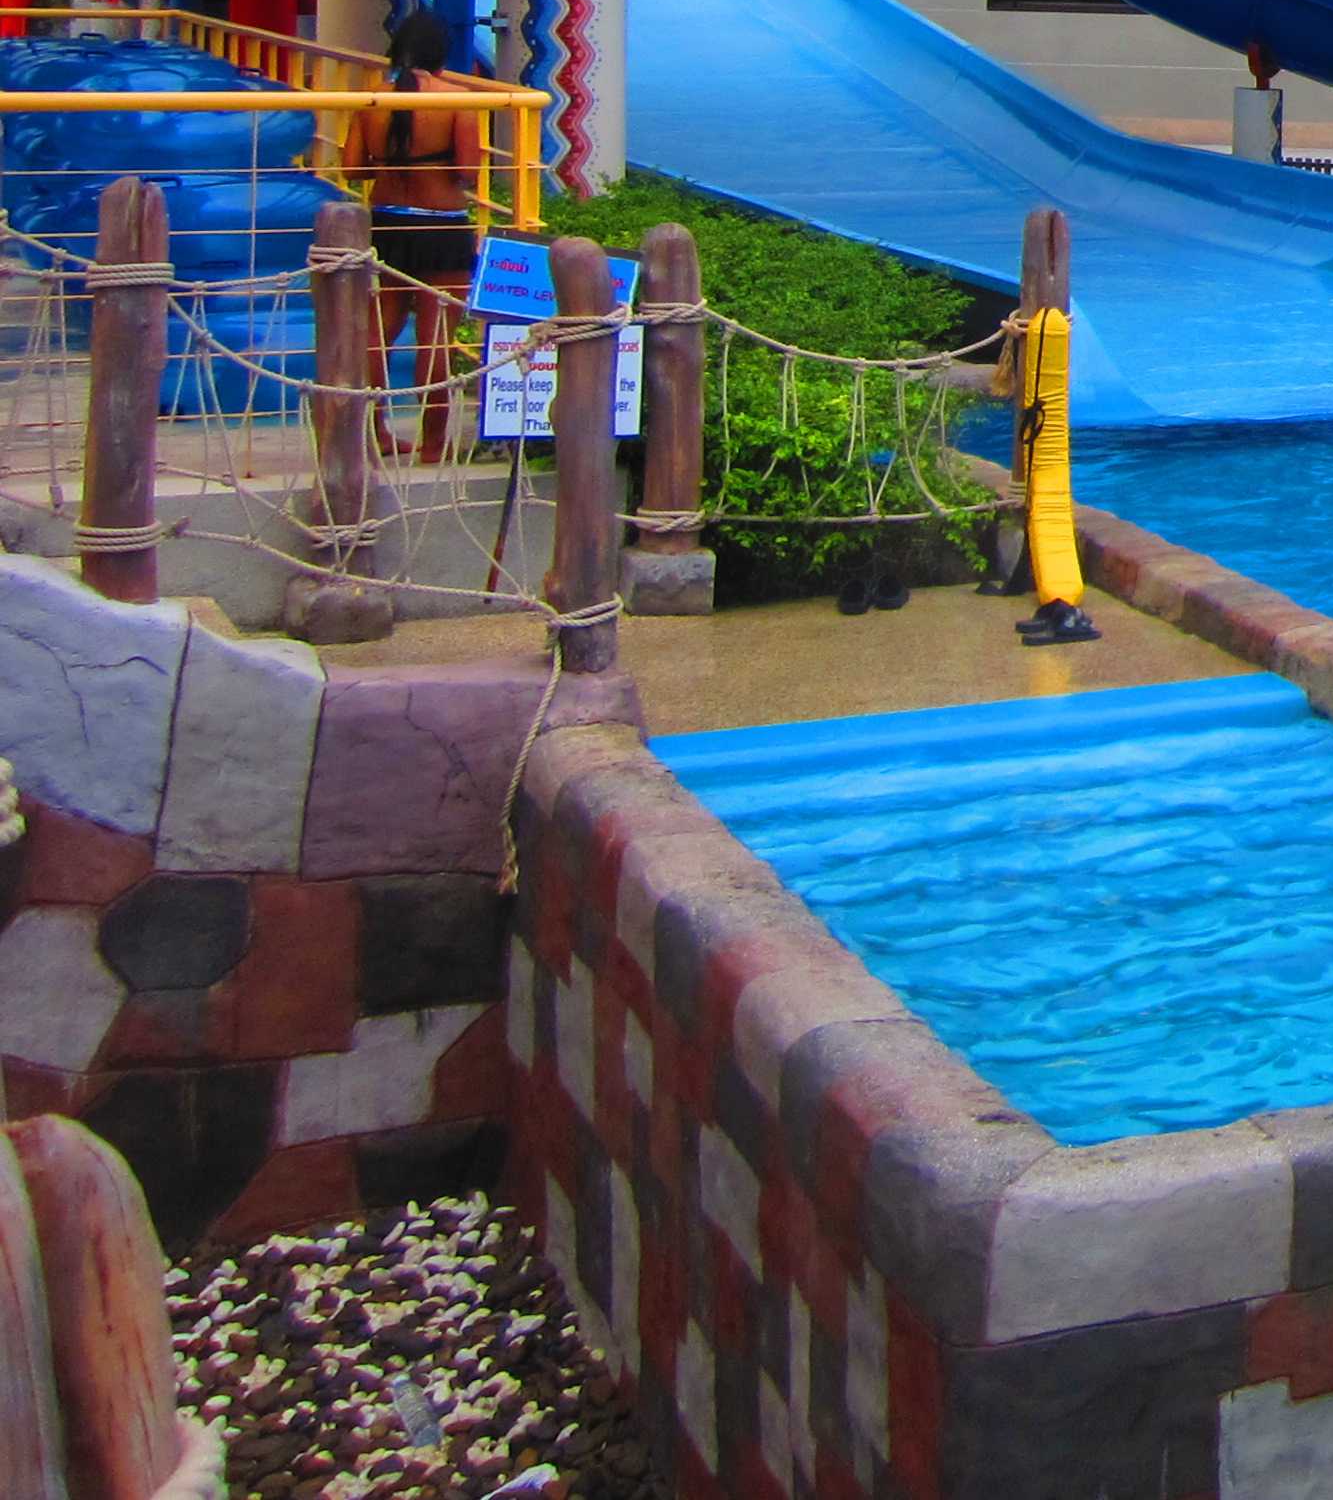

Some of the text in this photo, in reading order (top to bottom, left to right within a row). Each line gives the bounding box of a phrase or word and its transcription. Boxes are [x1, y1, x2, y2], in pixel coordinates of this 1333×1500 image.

[484, 281, 529, 297] WATER
[491, 377, 636, 395] Please keep the
[495, 398, 517, 412] First
